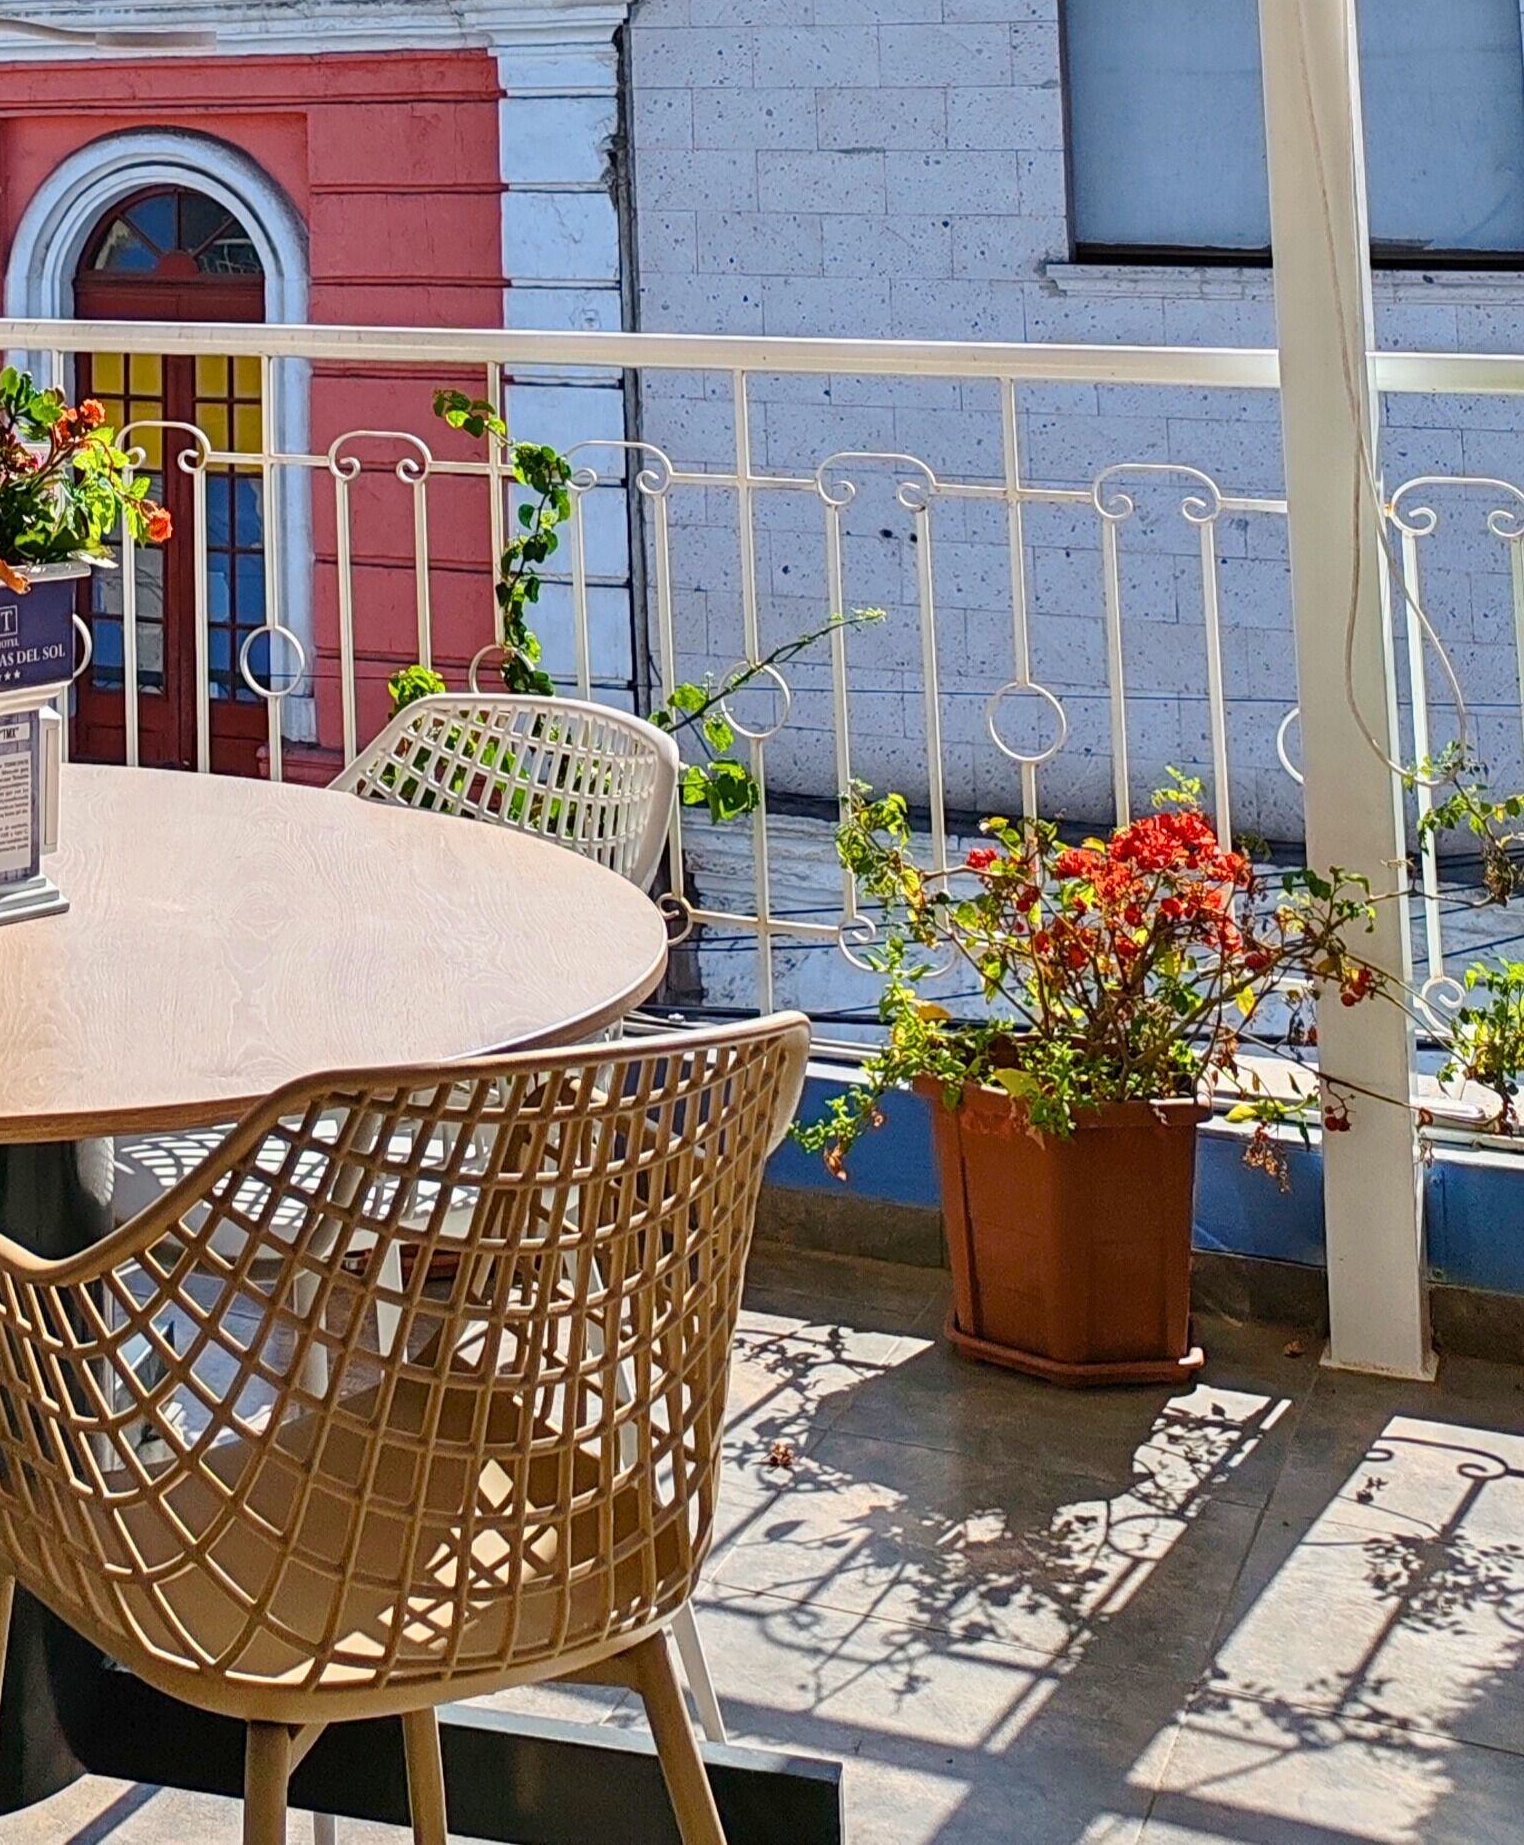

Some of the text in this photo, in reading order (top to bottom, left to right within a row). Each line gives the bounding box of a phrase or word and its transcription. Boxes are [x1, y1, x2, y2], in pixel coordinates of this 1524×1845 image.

[0, 610, 13, 632] T
[16, 647, 40, 664] DEL
[42, 643, 65, 660] SOL
